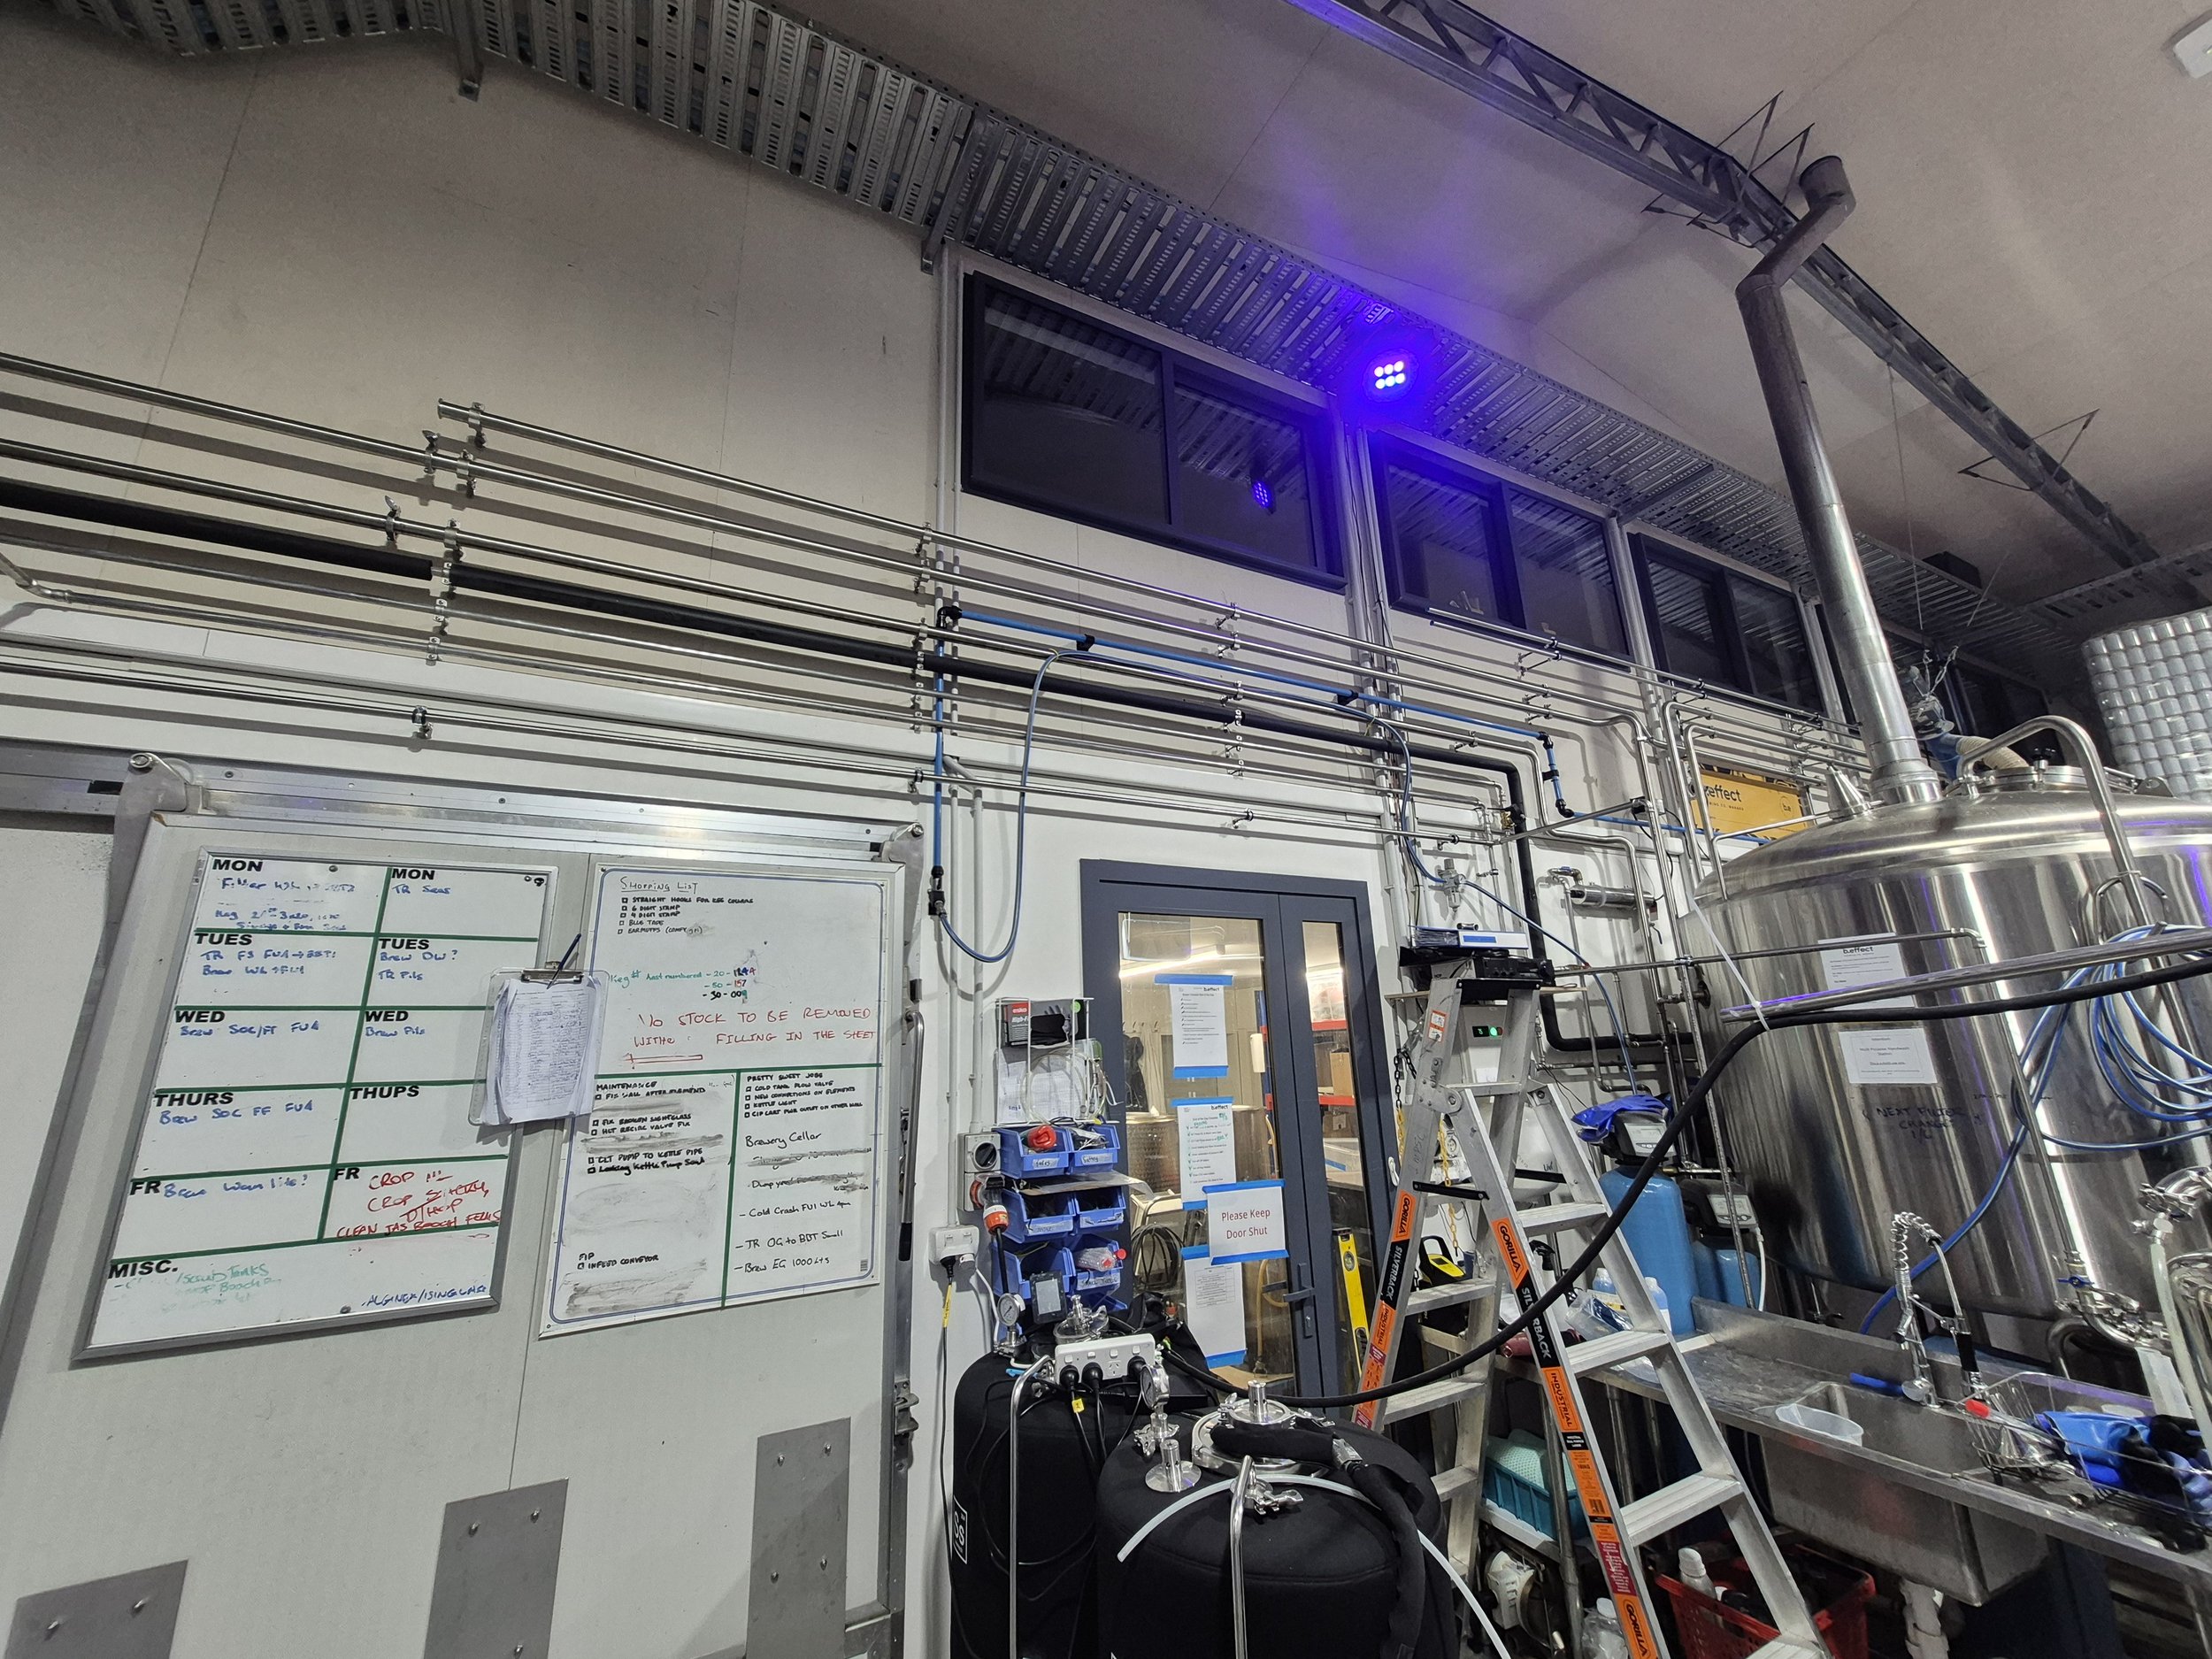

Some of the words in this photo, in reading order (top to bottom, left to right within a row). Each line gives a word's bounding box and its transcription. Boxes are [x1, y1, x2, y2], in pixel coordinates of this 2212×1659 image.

[212, 859, 263, 872] MON
[391, 868, 435, 880] MON
[195, 933, 253, 946] TUES
[379, 938, 430, 950] TUES
[175, 1010, 225, 1023] WED
[365, 1010, 409, 1022] WED
[678, 1012, 726, 1026] STOCK
[737, 1012, 757, 1024] TO
[767, 1010, 789, 1022] BE
[803, 1007, 872, 1019] REMOVED
[716, 1033, 777, 1045] FILLING
[786, 1032, 802, 1042] IN
[812, 1030, 835, 1040] THE
[154, 1093, 234, 1106] THURS
[745, 1135, 787, 1149] Brewery
[789, 1131, 822, 1142] Cellar
[333, 1167, 360, 1180] FR
[129, 1179, 161, 1195] FR
[749, 1208, 771, 1217] Cold
[773, 1206, 800, 1215] Crash
[1221, 1210, 1248, 1222] Please
[1249, 1208, 1271, 1219] Keep
[1397, 1197, 1409, 1233] GORILLA
[1226, 1229, 1247, 1240] Door
[1248, 1225, 1268, 1236] Shut
[785, 1235, 797, 1245] to
[1499, 1225, 1520, 1272] GORILLA
[108, 1260, 178, 1279] MISC.
[744, 1263, 767, 1273] Brew
[1386, 1245, 1402, 1302] SILVERBACK
[1550, 1372, 1572, 1427] INDUSTRIAL
[1625, 1602, 1648, 1656] GORILLA
